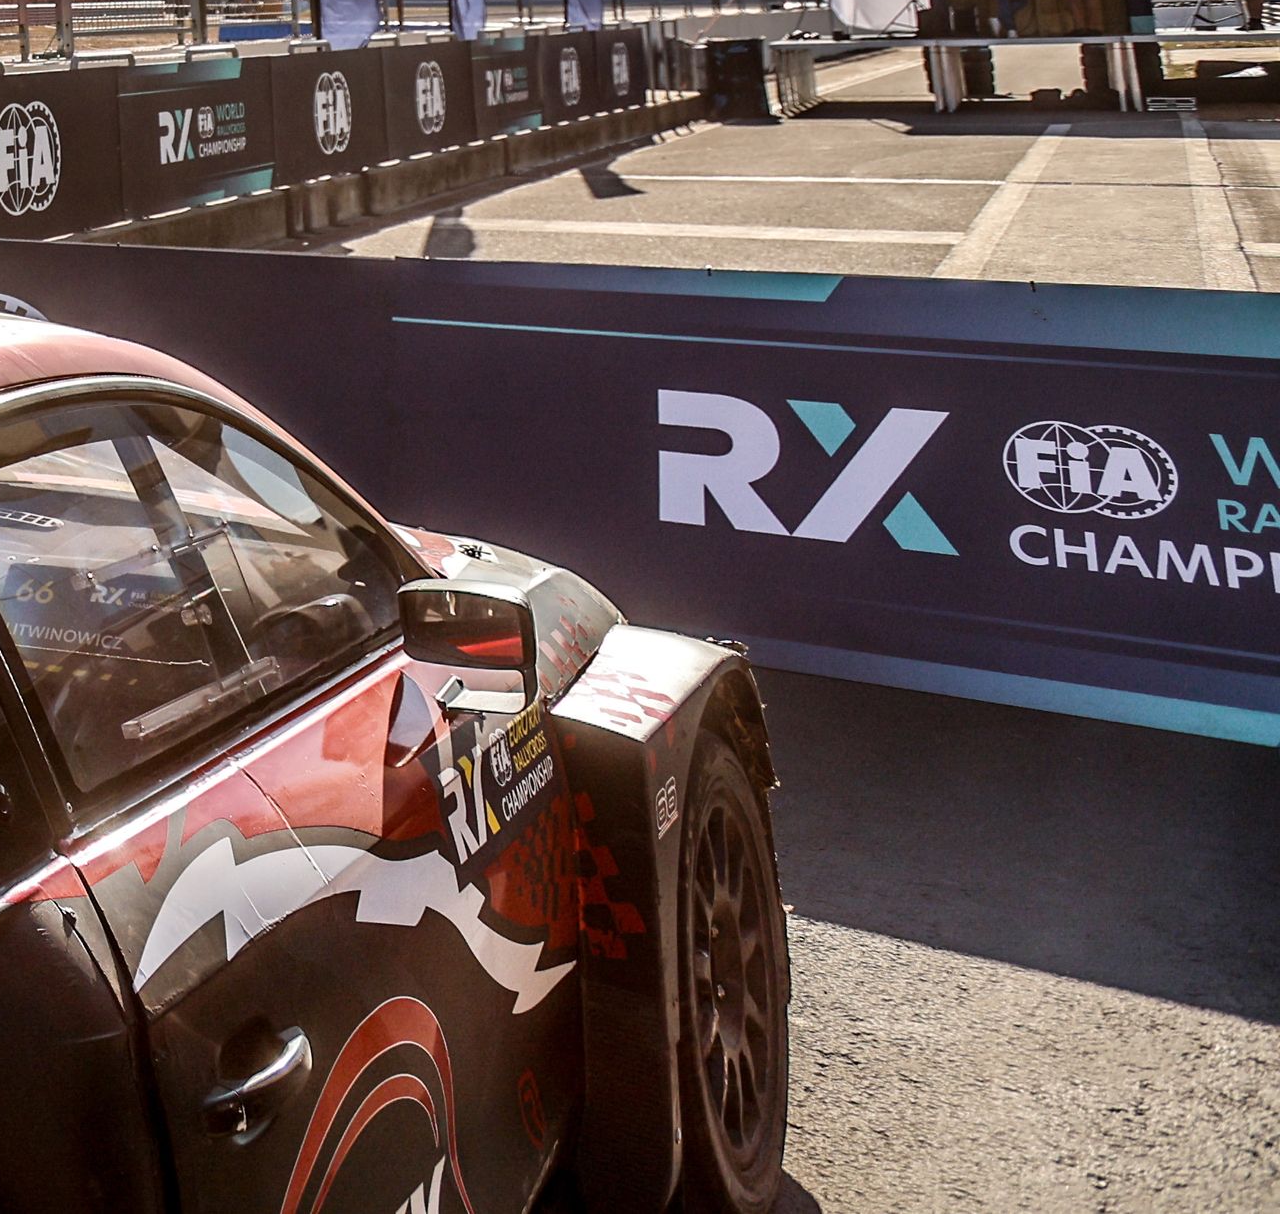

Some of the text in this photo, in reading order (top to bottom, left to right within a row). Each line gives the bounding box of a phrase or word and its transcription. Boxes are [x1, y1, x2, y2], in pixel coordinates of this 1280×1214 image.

[159, 108, 195, 165] RX
[216, 102, 245, 121] WORLD
[199, 137, 247, 157] CHAMPIONSHIP
[658, 388, 961, 557] RX
[16, 579, 54, 604] 66
[90, 585, 127, 606] RX
[513, 730, 547, 774] RALLYCROSS
[437, 743, 501, 865] RX
[502, 755, 554, 822] CHAMPIONSHIP
